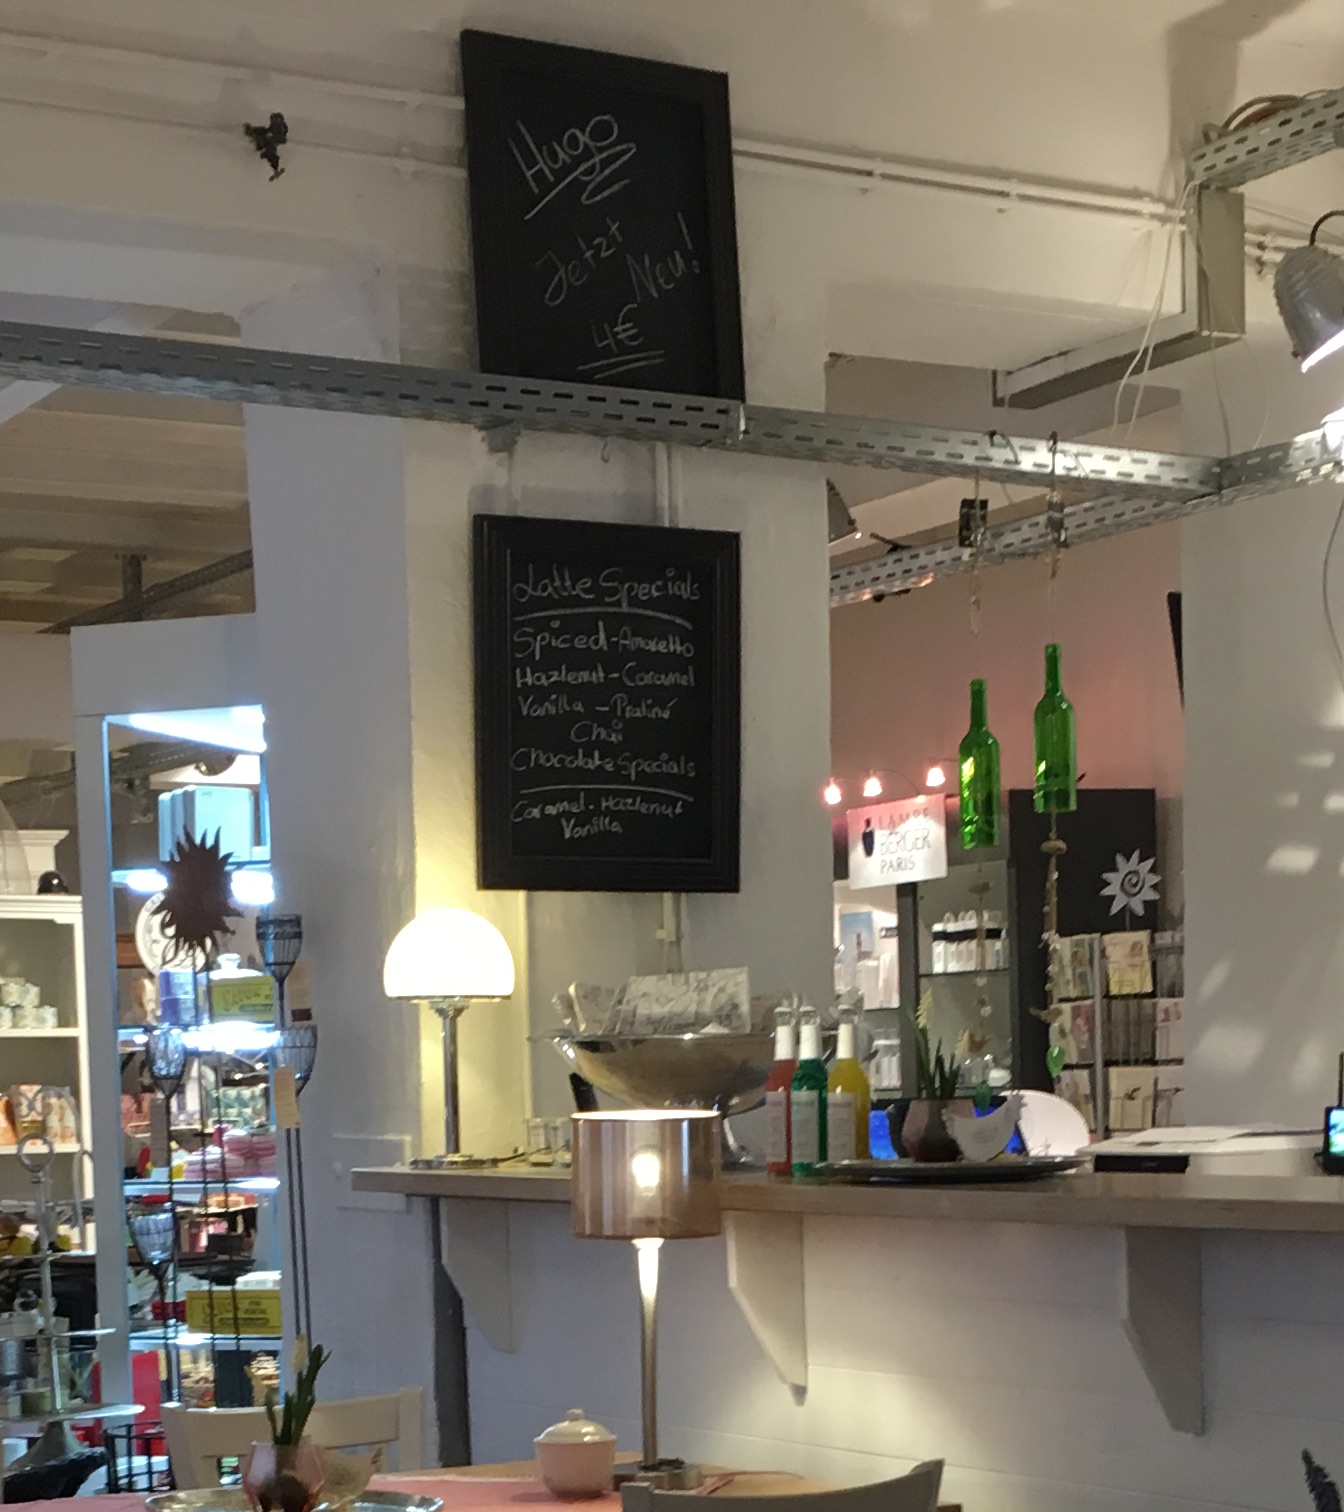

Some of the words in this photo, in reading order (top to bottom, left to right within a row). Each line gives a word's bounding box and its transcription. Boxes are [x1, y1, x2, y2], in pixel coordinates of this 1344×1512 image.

[508, 114, 618, 194] Hugo
[535, 216, 623, 306] Jetzt
[589, 303, 644, 353] 4€
[513, 563, 596, 602] Latte
[599, 567, 701, 610] Specials
[518, 693, 585, 718] Vanilla
[570, 719, 624, 743] Chai
[510, 748, 614, 772] Chocolate
[617, 752, 696, 781] Specials
[561, 815, 624, 839] Vanilla
[880, 828, 931, 855] BERGER
[880, 855, 916, 874] PARIS
